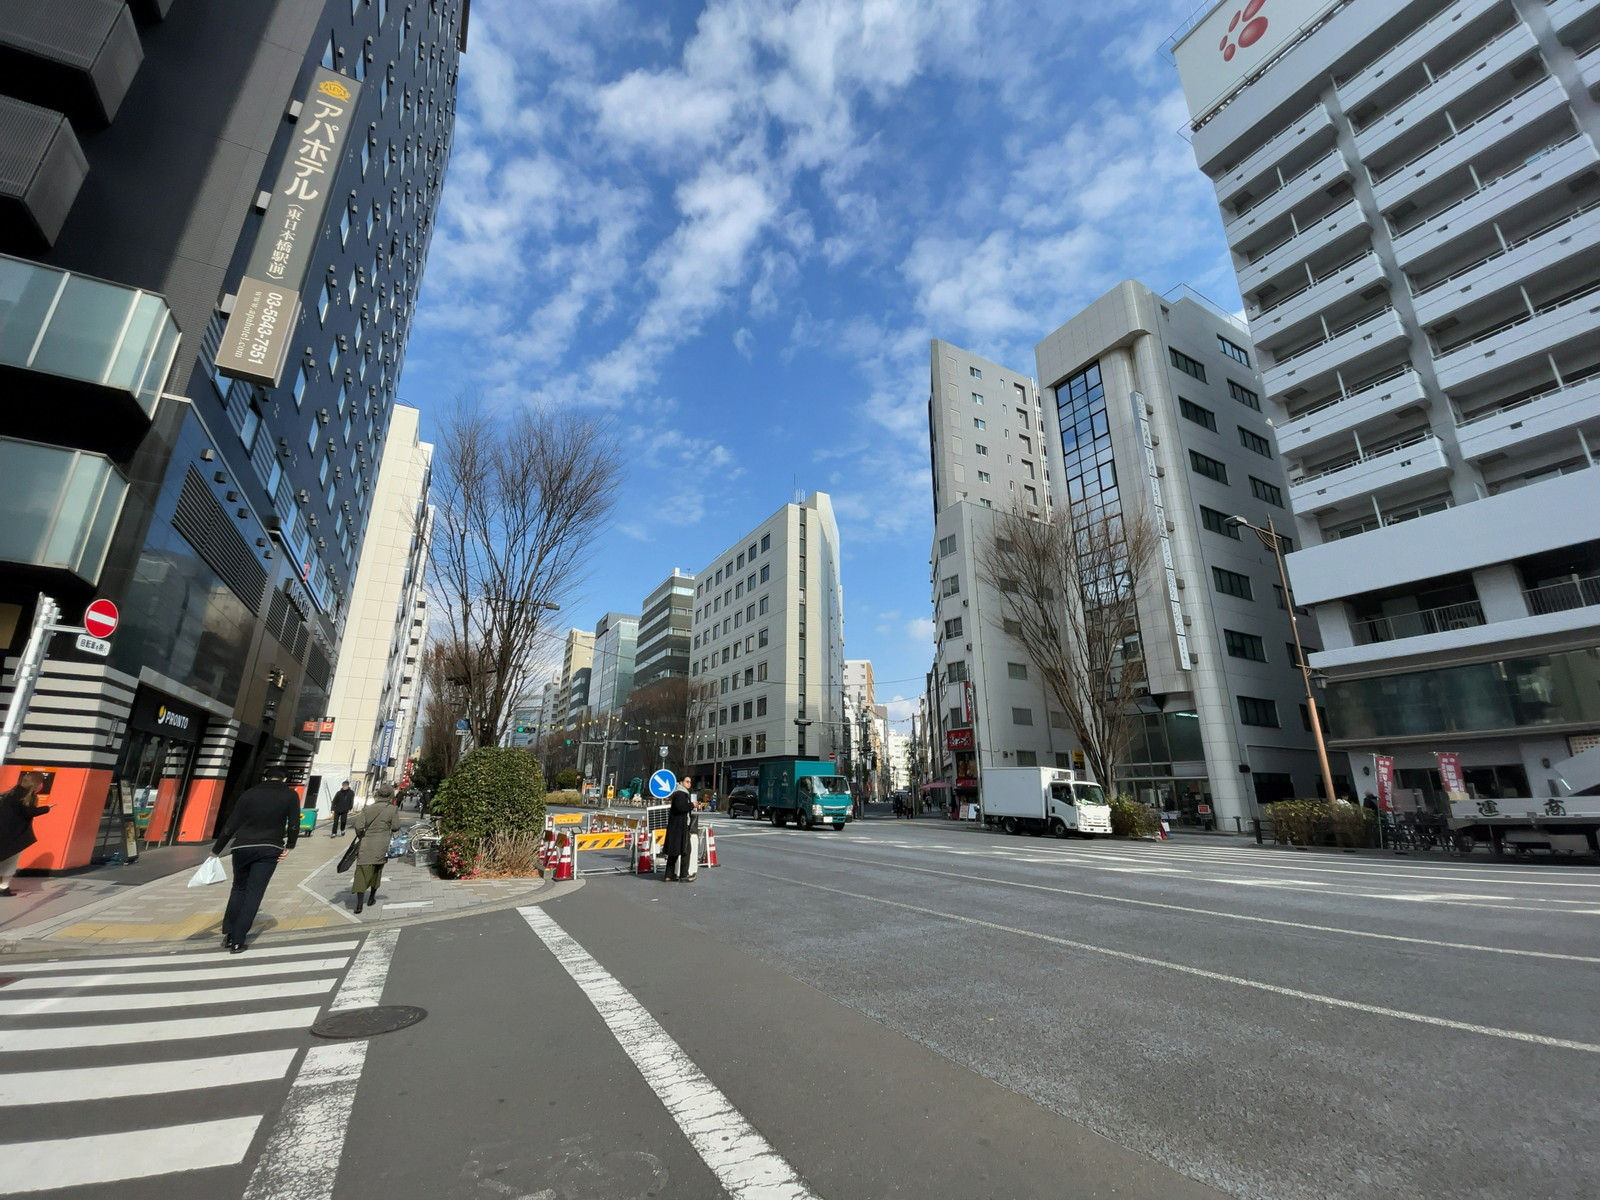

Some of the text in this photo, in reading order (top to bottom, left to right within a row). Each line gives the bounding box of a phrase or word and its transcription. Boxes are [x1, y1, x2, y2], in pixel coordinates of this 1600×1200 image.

[285, 99, 344, 201] アパホテル
[234, 291, 262, 358] www.apahotel.com
[248, 292, 283, 365] 03-5643-7551
[165, 711, 189, 730] PRONTO
[1543, 798, 1567, 817] 商
